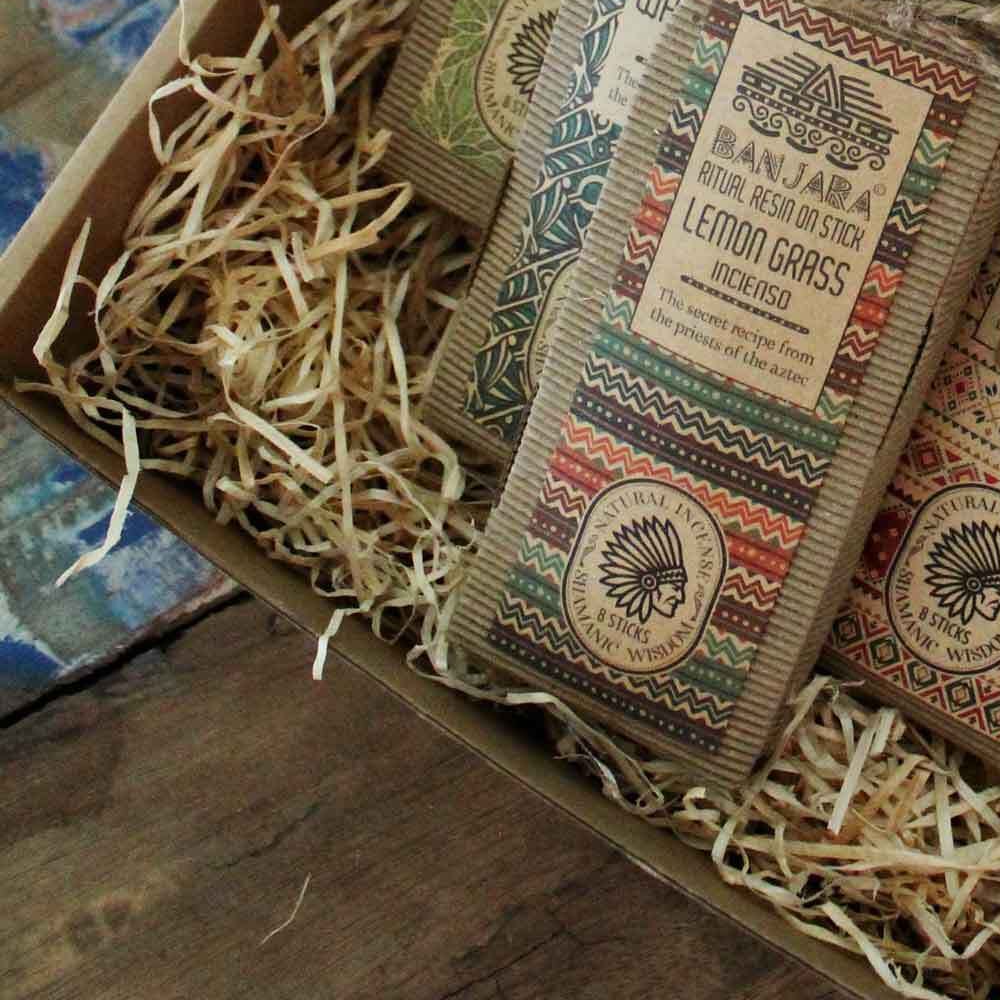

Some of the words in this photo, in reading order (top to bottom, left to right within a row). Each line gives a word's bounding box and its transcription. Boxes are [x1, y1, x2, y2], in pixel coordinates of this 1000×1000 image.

[698, 160, 747, 203] RITUAL
[750, 185, 796, 225] RESIN
[795, 204, 819, 234] ON
[819, 214, 865, 252] STICK
[712, 124, 871, 222] BANJARA
[682, 197, 767, 264] LEMON
[768, 237, 851, 297] GRASS
[711, 260, 792, 310] INCIENSO
[650, 306, 673, 328] the
[673, 321, 721, 351] priests
[724, 344, 740, 360] of
[743, 351, 768, 371] the
[769, 364, 809, 386] aztec
[659, 286, 685, 310] The
[687, 305, 729, 330] secret
[731, 324, 776, 351] recipe
[778, 340, 815, 366] from
[594, 491, 666, 530] NATURAL
[675, 503, 713, 582] INCENSE
[921, 495, 1000, 537] NATURAL
[572, 568, 621, 651] SHAMANIC
[596, 607, 607, 623] 8
[608, 613, 651, 645] STICKS
[895, 568, 939, 650] SHAMANIC
[918, 607, 929, 621] 8
[931, 612, 972, 645] STICKS
